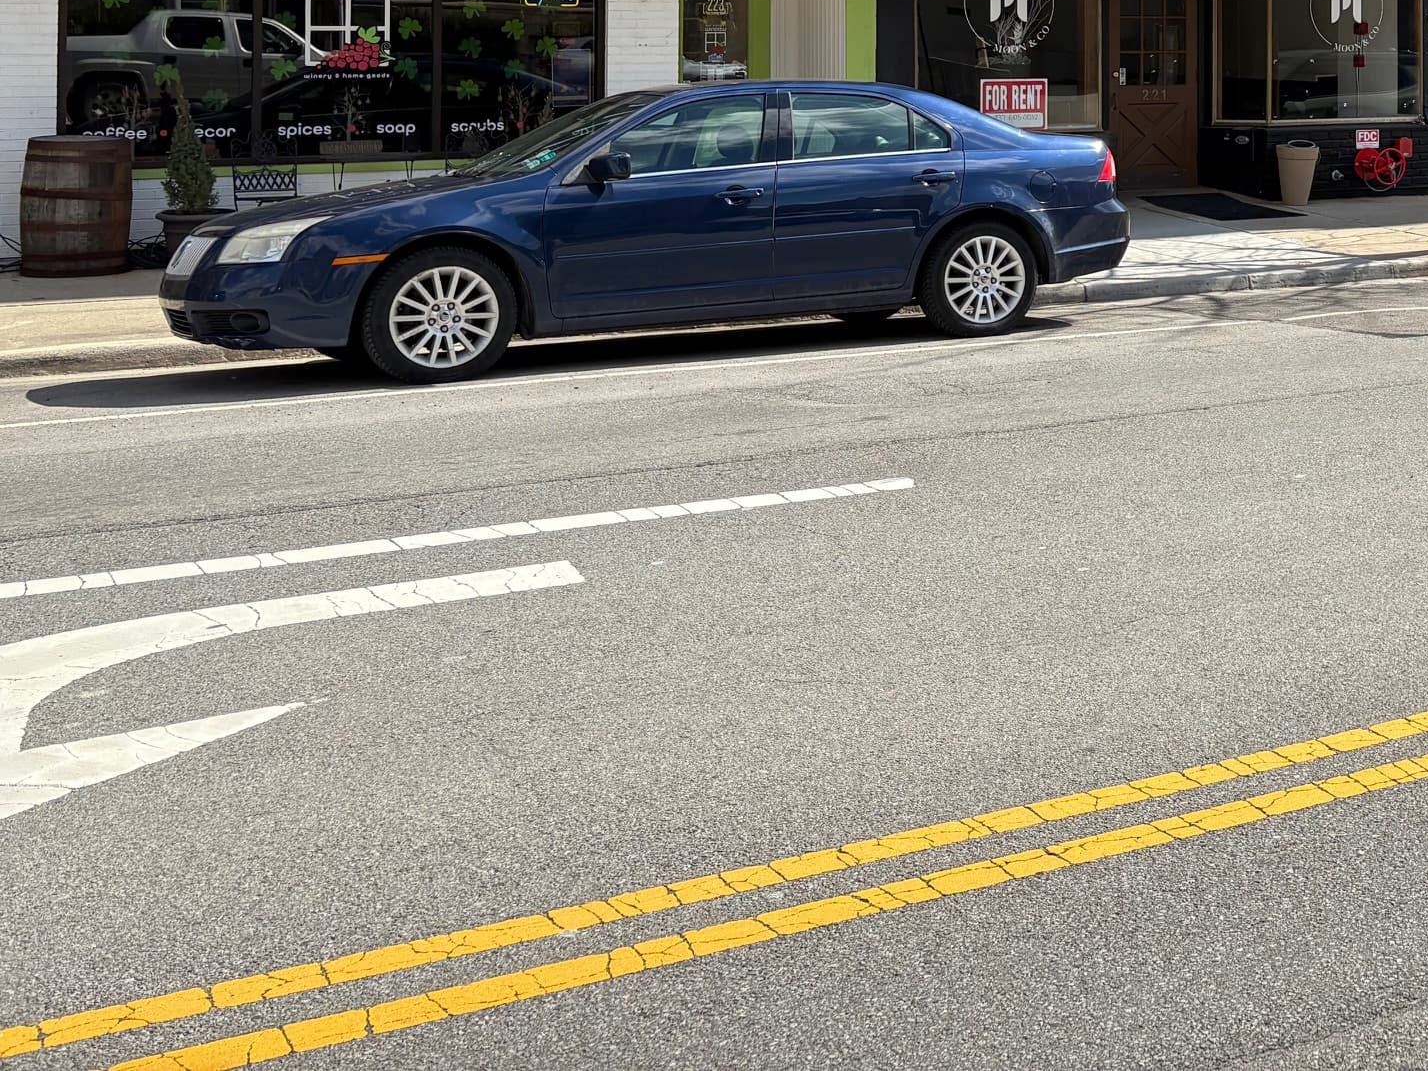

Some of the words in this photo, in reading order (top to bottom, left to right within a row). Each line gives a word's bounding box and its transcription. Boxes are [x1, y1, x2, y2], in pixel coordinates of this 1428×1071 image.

[992, 42, 1028, 54] MOON
[1028, 39, 1038, 48] &
[1036, 25, 1050, 40] CO
[1334, 41, 1363, 53] MOON
[985, 84, 1008, 111] FOR
[1011, 84, 1043, 111] RENT
[1142, 89, 1167, 101] 221
[278, 123, 332, 139] spices
[376, 123, 416, 137] soap
[451, 119, 505, 133] scrubs
[1358, 131, 1378, 142] FDC
